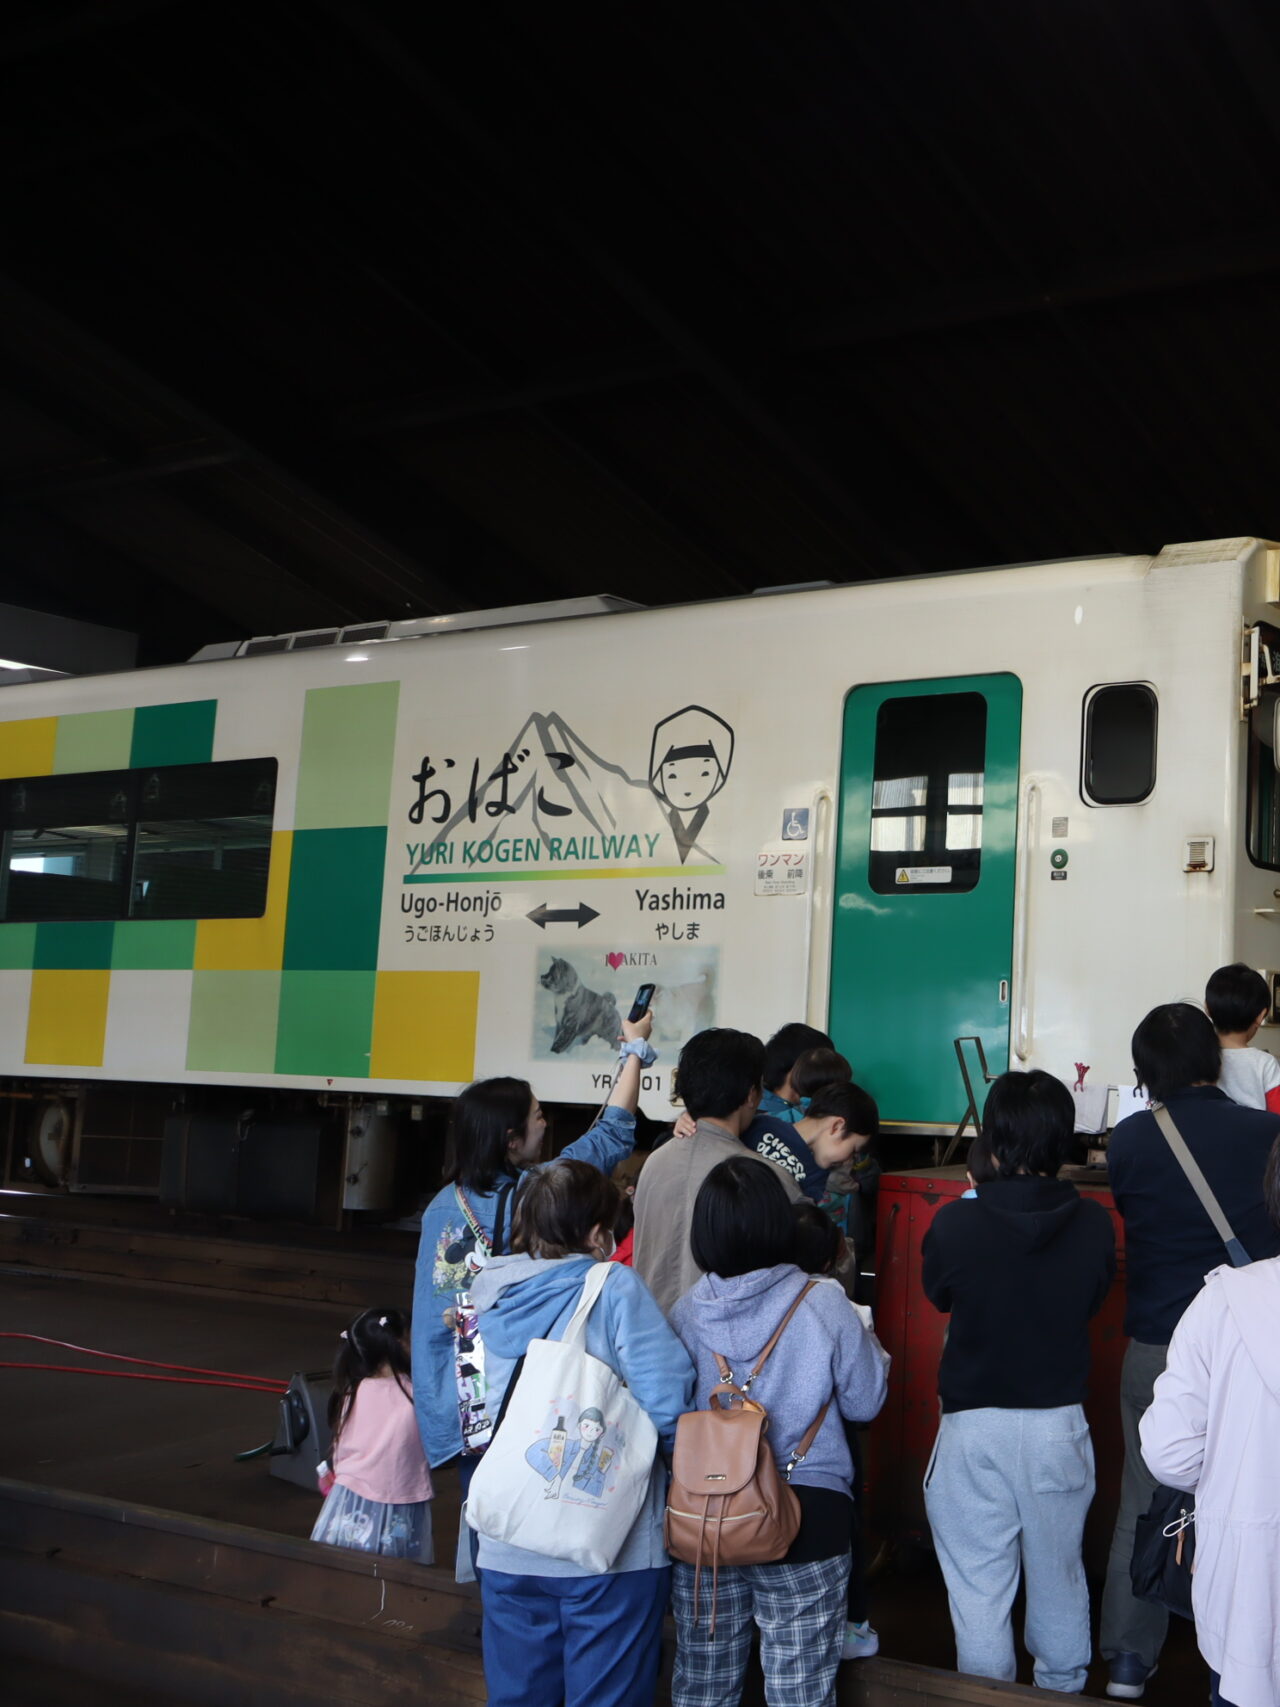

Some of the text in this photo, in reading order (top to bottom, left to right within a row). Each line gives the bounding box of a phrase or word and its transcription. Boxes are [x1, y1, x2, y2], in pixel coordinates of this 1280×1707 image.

[408, 749, 576, 824] おばこ
[406, 833, 661, 866] YURI KOGEN RAILWAY
[758, 853, 805, 867] ワンマン
[401, 890, 502, 918] Ugo-Honjō
[635, 887, 725, 911] Yashima
[404, 924, 495, 942] うごほんじょう
[655, 922, 700, 940] やしま
[622, 953, 658, 966] AKITA
[763, 1132, 806, 1182] CHEESE
